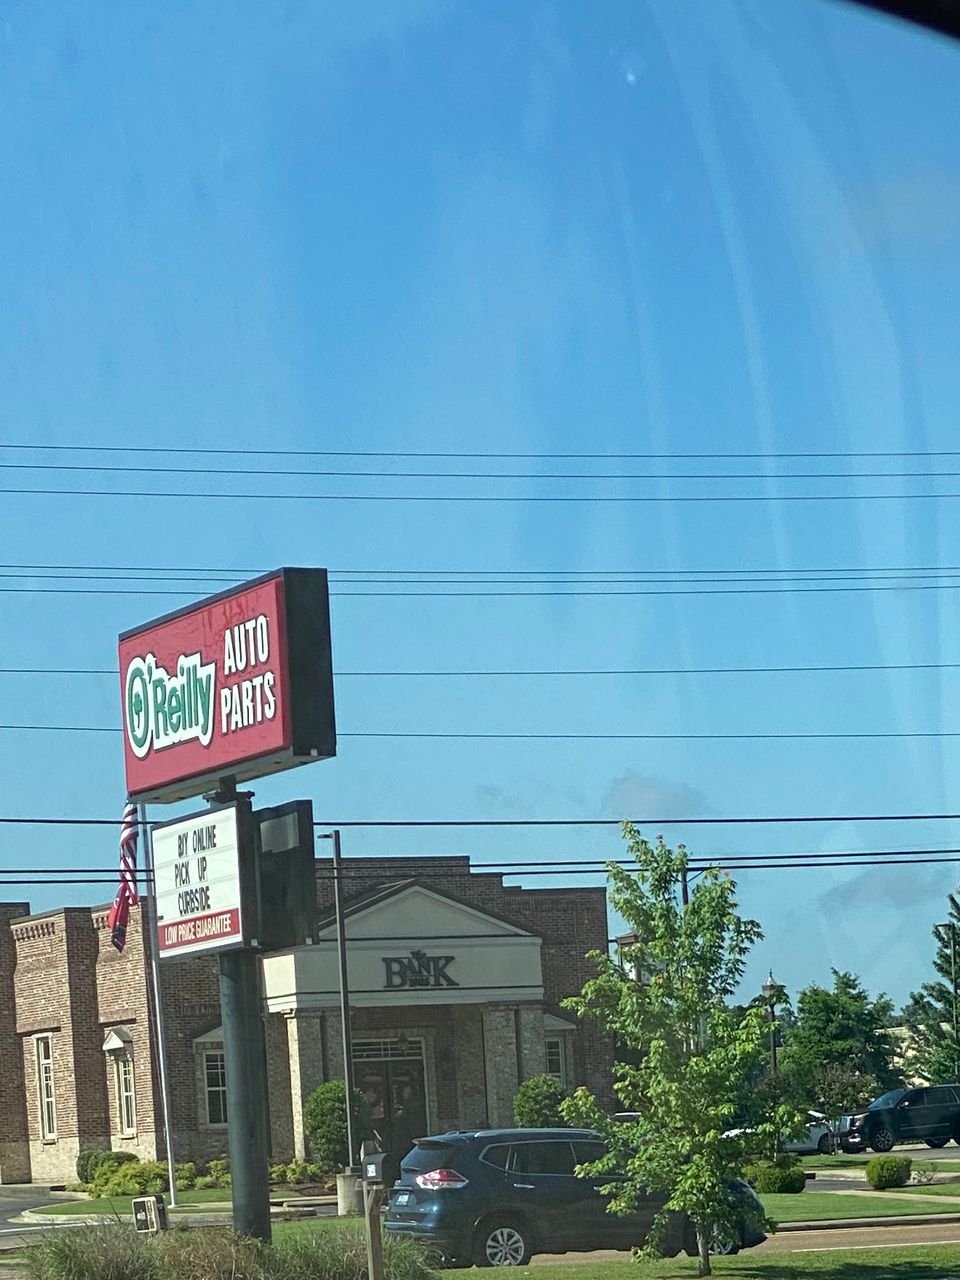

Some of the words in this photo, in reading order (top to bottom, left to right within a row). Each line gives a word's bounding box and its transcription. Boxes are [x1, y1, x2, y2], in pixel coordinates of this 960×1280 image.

[224, 614, 269, 675] AUTO
[126, 655, 214, 754] O'Reilly
[220, 671, 275, 734] PARTS
[177, 831, 188, 858] BUY
[192, 825, 217, 853] ONLINE
[174, 861, 190, 887] PICK
[197, 856, 207, 882] UP
[177, 886, 211, 916] CURBSIDE
[164, 924, 177, 945] LOW
[178, 920, 195, 943] PRICE
[195, 914, 232, 939] GUARANTEE
[382, 955, 460, 988] BANK
